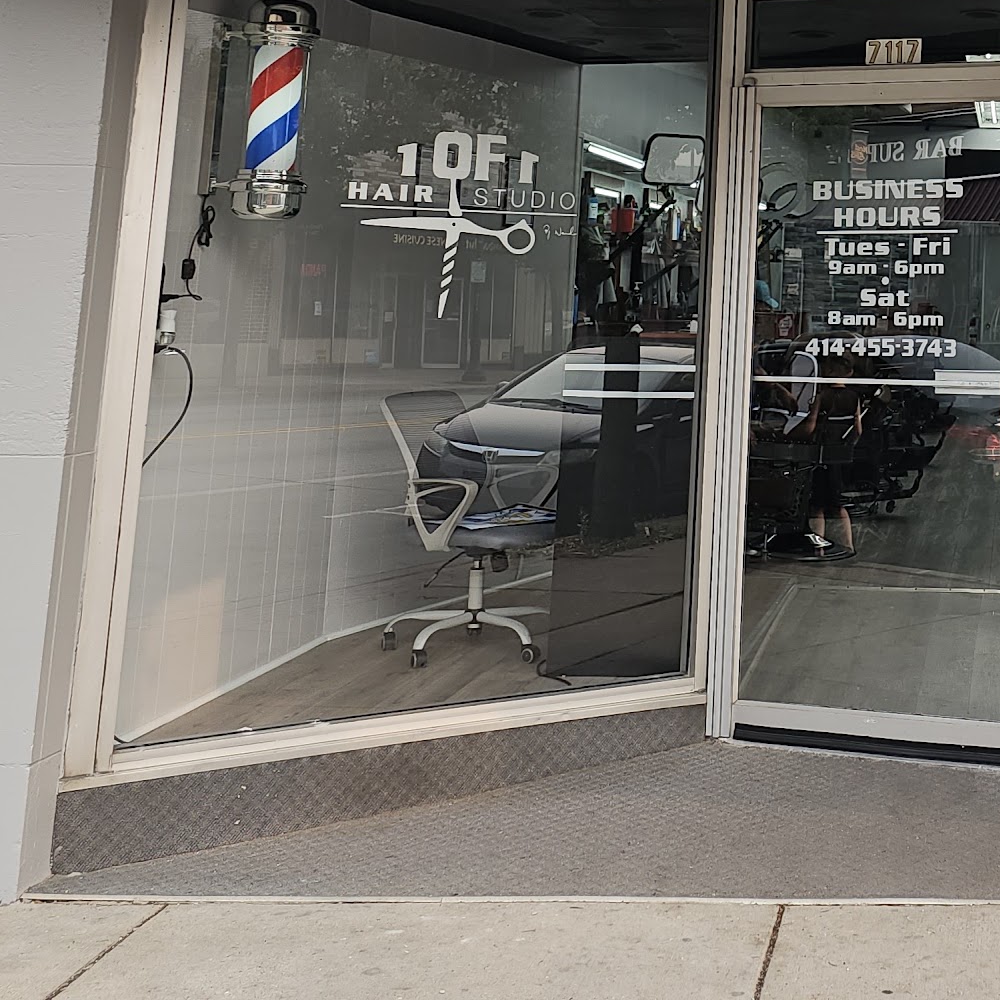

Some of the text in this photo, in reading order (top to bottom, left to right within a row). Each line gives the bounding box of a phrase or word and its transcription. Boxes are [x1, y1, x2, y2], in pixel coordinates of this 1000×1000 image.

[868, 39, 920, 65] 7117
[397, 131, 540, 184] 1 OF 1
[347, 181, 576, 211] HAIR STUDIO
[812, 178, 964, 201] BUSINESS
[833, 206, 941, 228] HOURS
[824, 237, 890, 256] Tues
[912, 237, 951, 256] Fri
[828, 260, 877, 275] 9am
[894, 260, 945, 278] 6pm
[860, 288, 910, 307] Sat
[827, 310, 876, 326] 8am
[893, 311, 944, 330] 6pm
[805, 338, 957, 358] 414-455-3743
